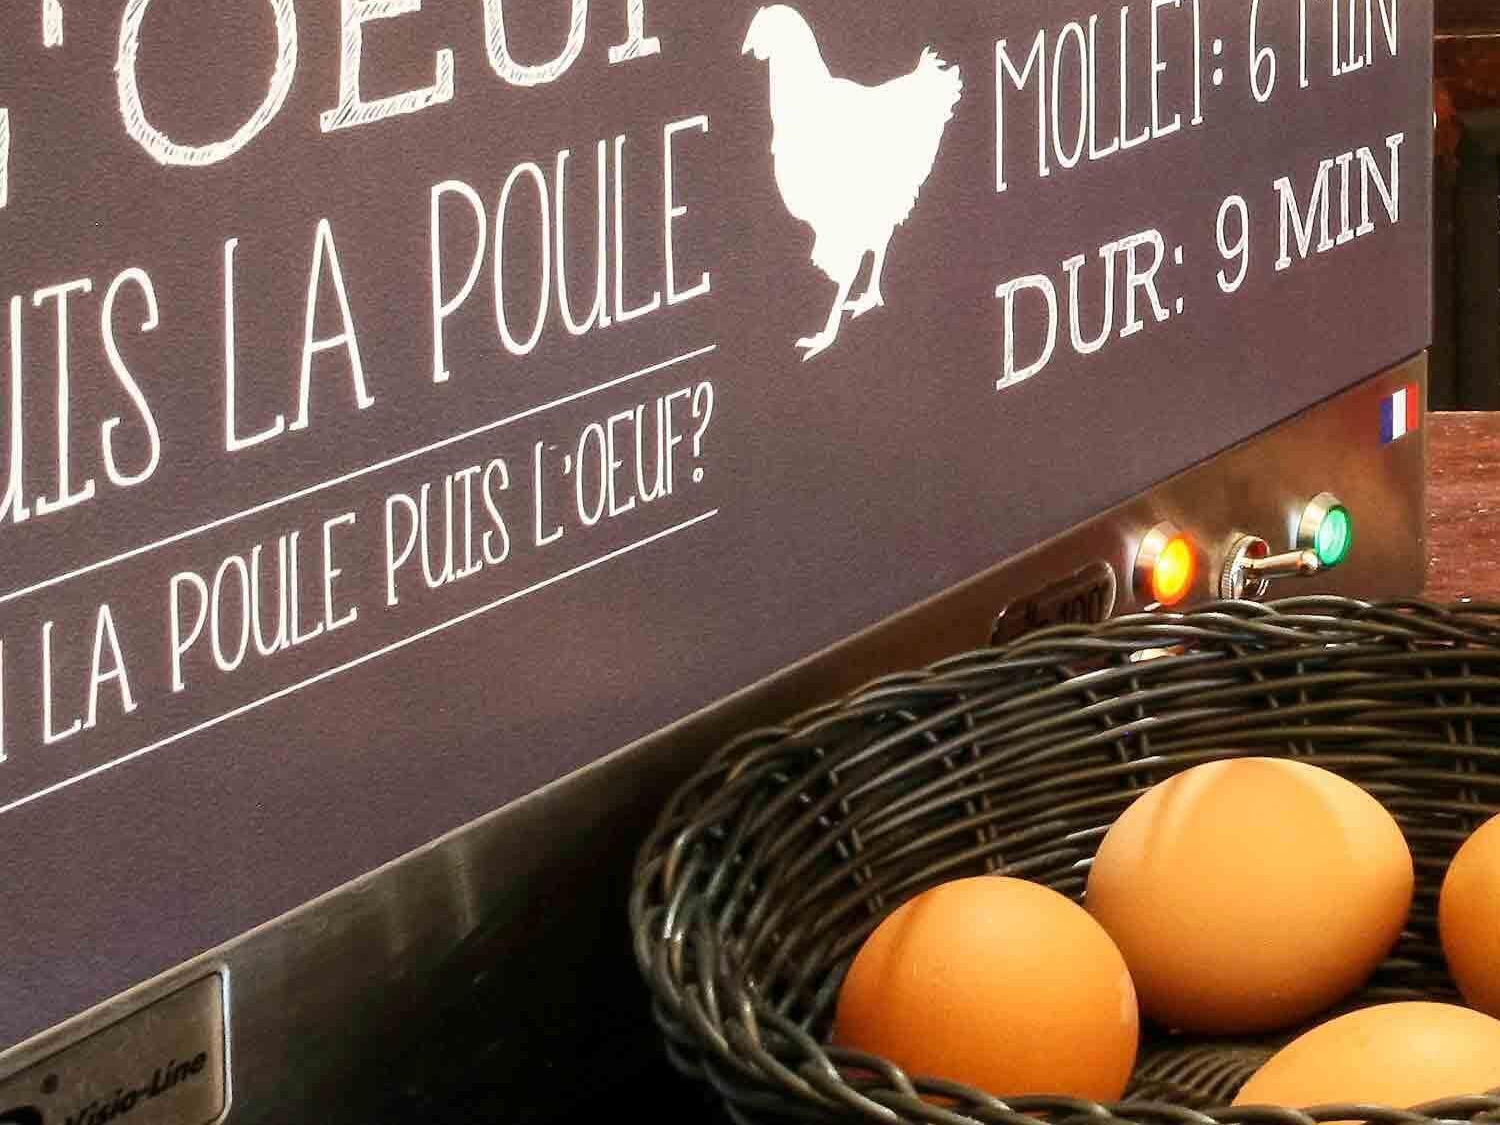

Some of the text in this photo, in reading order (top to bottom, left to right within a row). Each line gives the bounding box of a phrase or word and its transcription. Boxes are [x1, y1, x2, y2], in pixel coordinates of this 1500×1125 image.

[225, 219, 375, 452] LA
[431, 115, 711, 382] POULE
[995, 133, 1404, 391] DUR: 9 MIN
[43, 605, 137, 745] LA
[170, 512, 357, 692] POULE
[386, 458, 511, 606] PUIS
[534, 381, 714, 547] L'OEUF?
